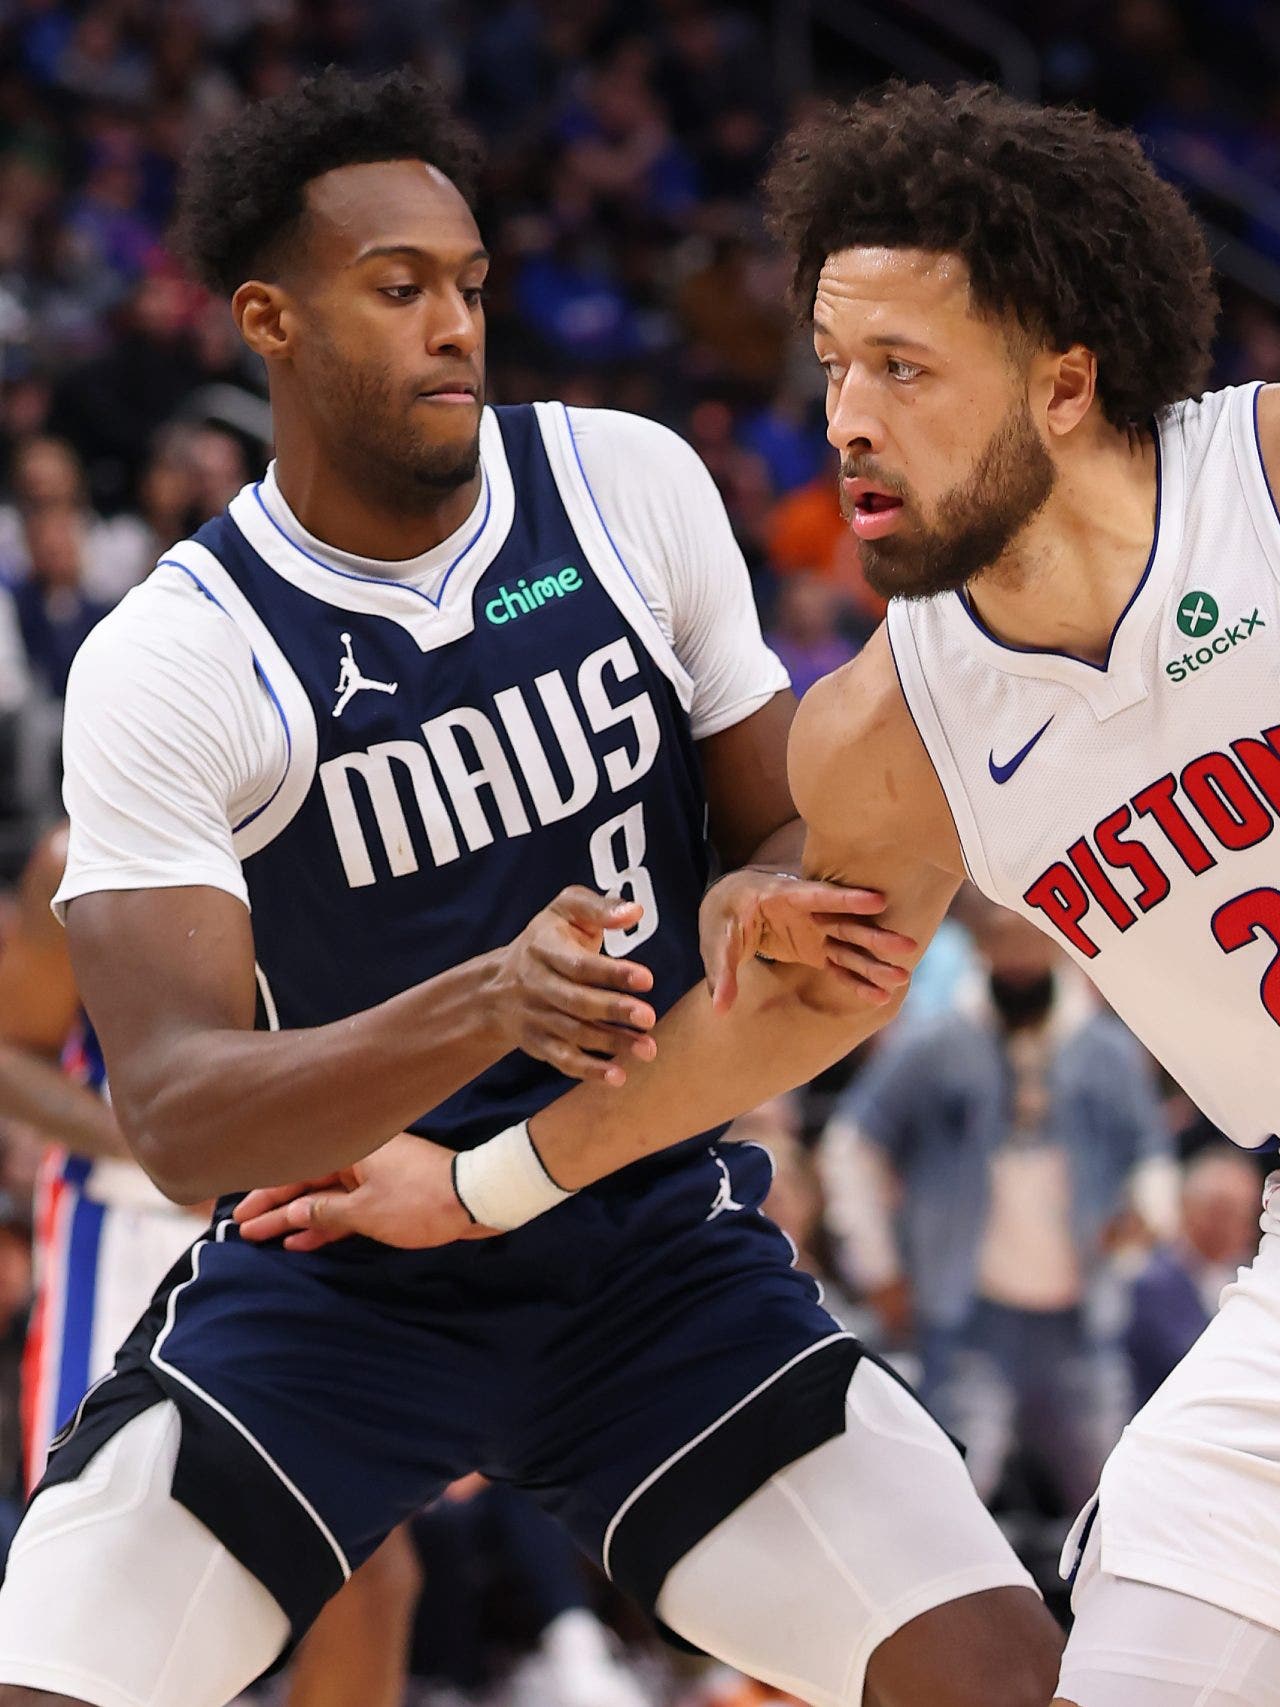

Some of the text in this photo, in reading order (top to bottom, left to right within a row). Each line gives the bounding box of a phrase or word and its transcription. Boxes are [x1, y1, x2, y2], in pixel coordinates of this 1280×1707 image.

[484, 563, 584, 626] chime
[1166, 608, 1266, 683] StockX
[589, 801, 660, 959] 8
